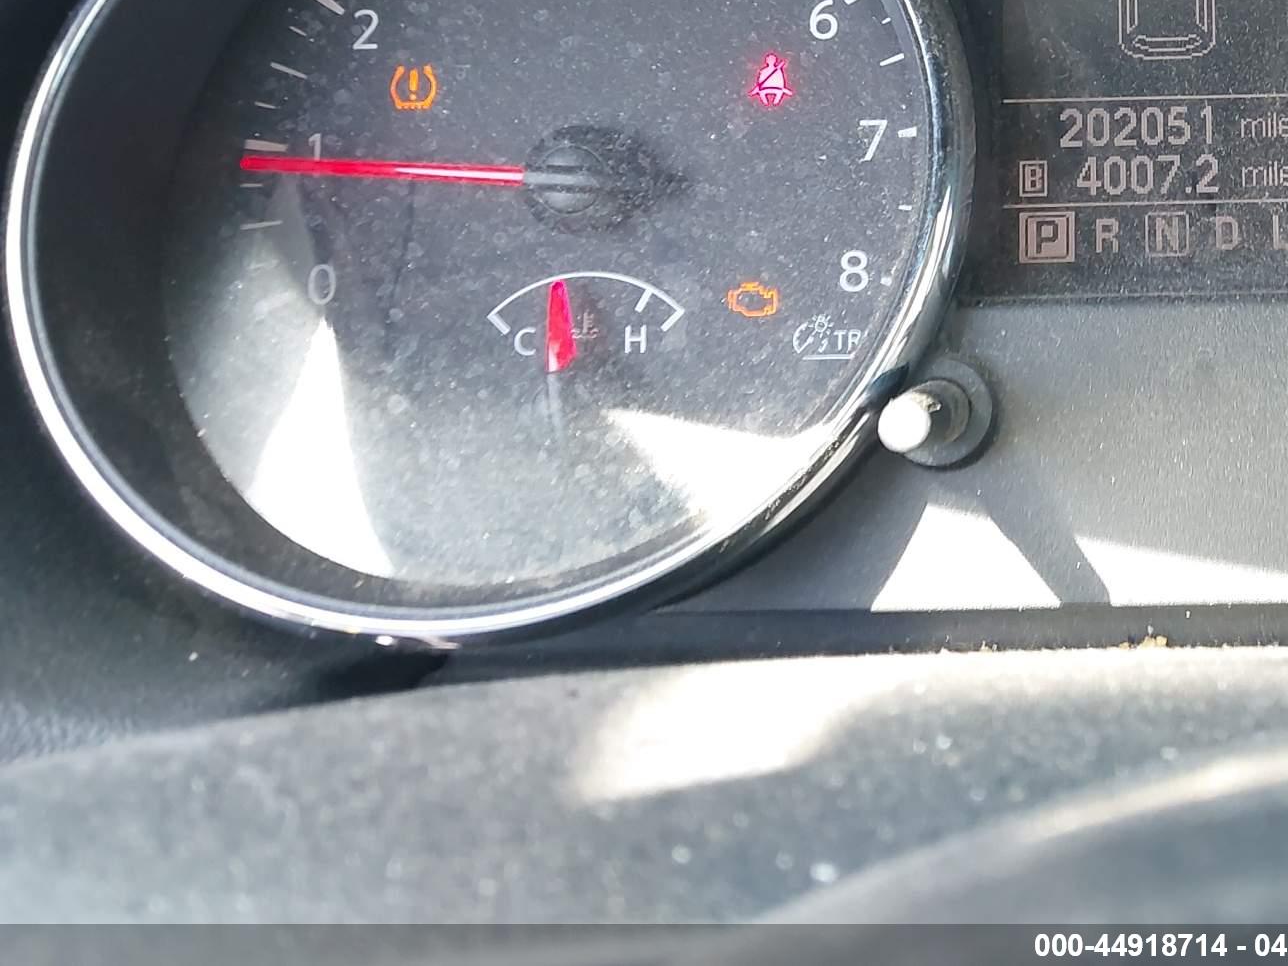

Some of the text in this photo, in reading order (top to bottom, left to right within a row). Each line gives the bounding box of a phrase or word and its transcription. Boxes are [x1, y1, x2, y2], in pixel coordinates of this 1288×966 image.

[352, 10, 379, 51] 2
[810, 0, 838, 40] 6
[859, 120, 888, 161] 7
[1060, 104, 1214, 149] 202051
[308, 133, 322, 178] 1
[1076, 153, 1219, 196] 4007.2
[1035, 220, 1058, 254] P
[1096, 218, 1119, 254] R
[1155, 217, 1180, 252] N
[1216, 216, 1239, 251] D
[307, 263, 336, 305] 0
[839, 250, 869, 293] 8
[514, 328, 537, 357] C
[624, 327, 647, 354] H
